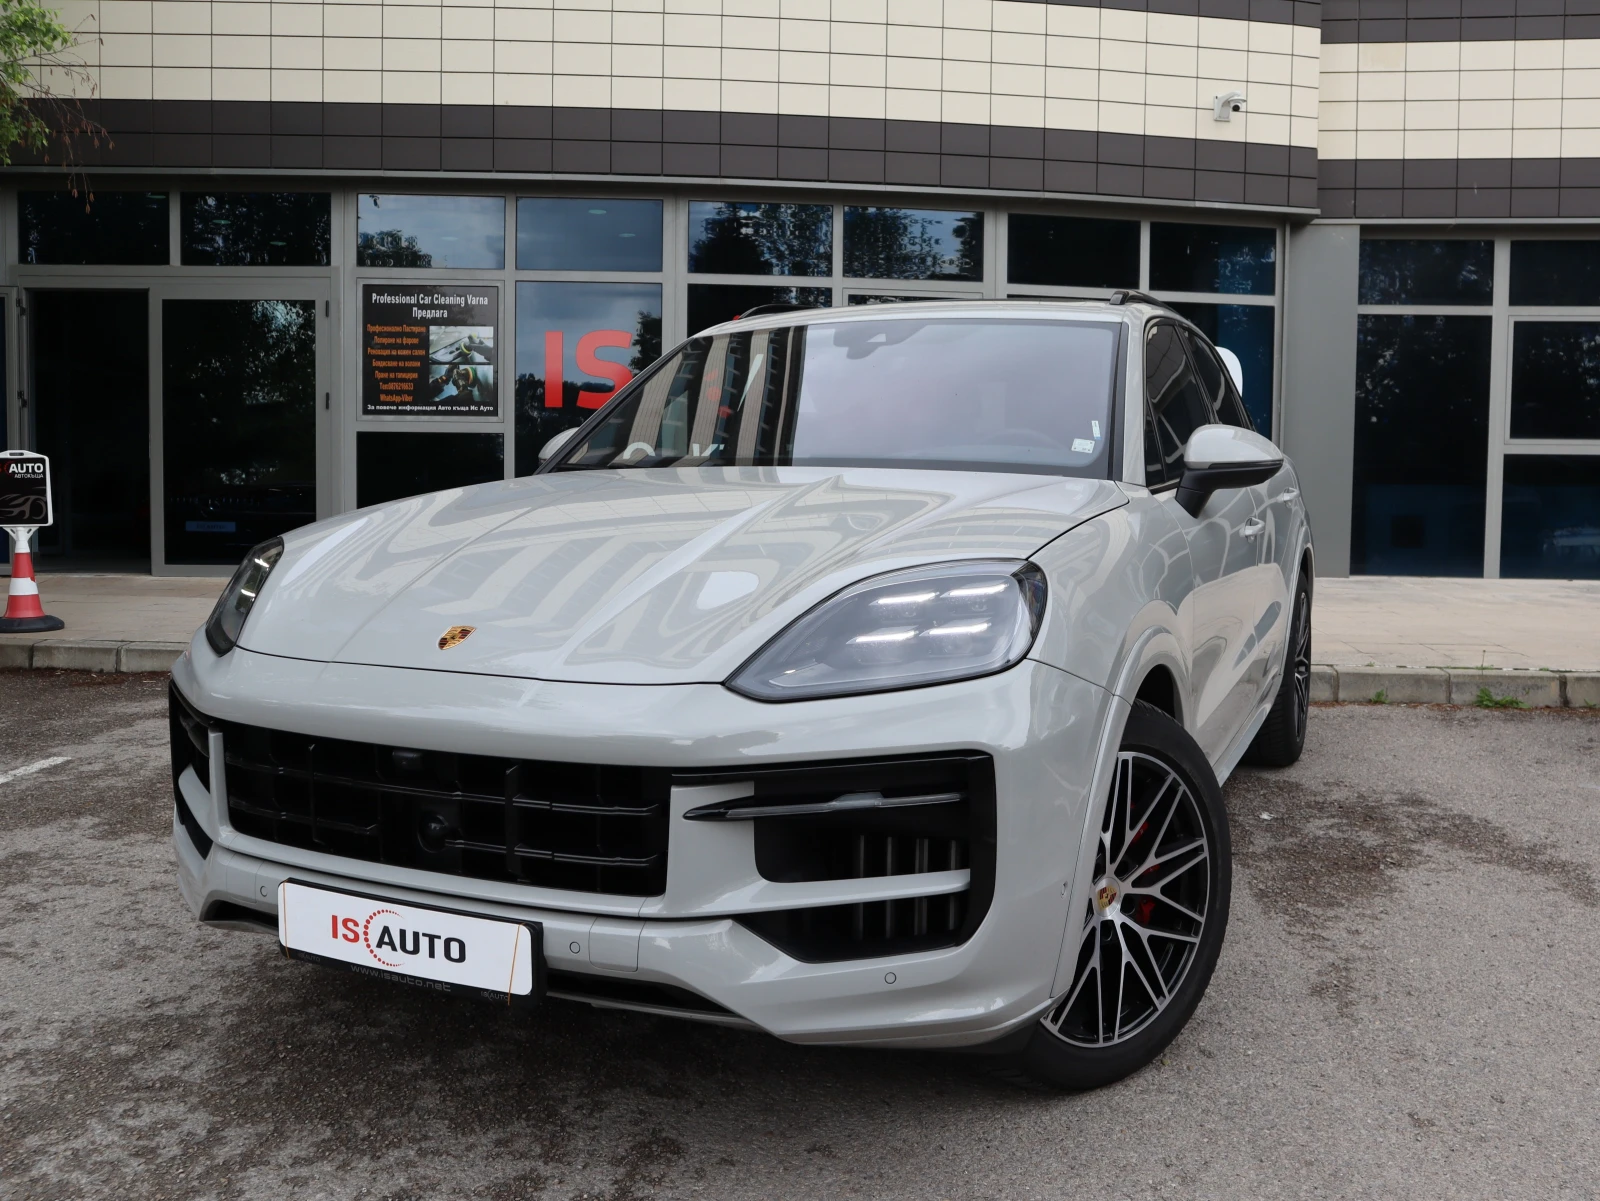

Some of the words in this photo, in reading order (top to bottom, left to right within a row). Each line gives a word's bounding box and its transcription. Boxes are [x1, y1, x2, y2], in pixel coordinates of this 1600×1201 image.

[372, 293, 417, 304] Professional
[419, 294, 431, 304] Car
[433, 294, 465, 307] Cleaning
[467, 295, 488, 305] Varna
[412, 307, 448, 319] Предлага
[544, 329, 633, 409] IS
[398, 404, 436, 412] информация
[9, 463, 44, 473] AUTO
[331, 914, 360, 943] IS
[375, 925, 467, 963] AUTO
[350, 963, 452, 993] www.isauto.net
